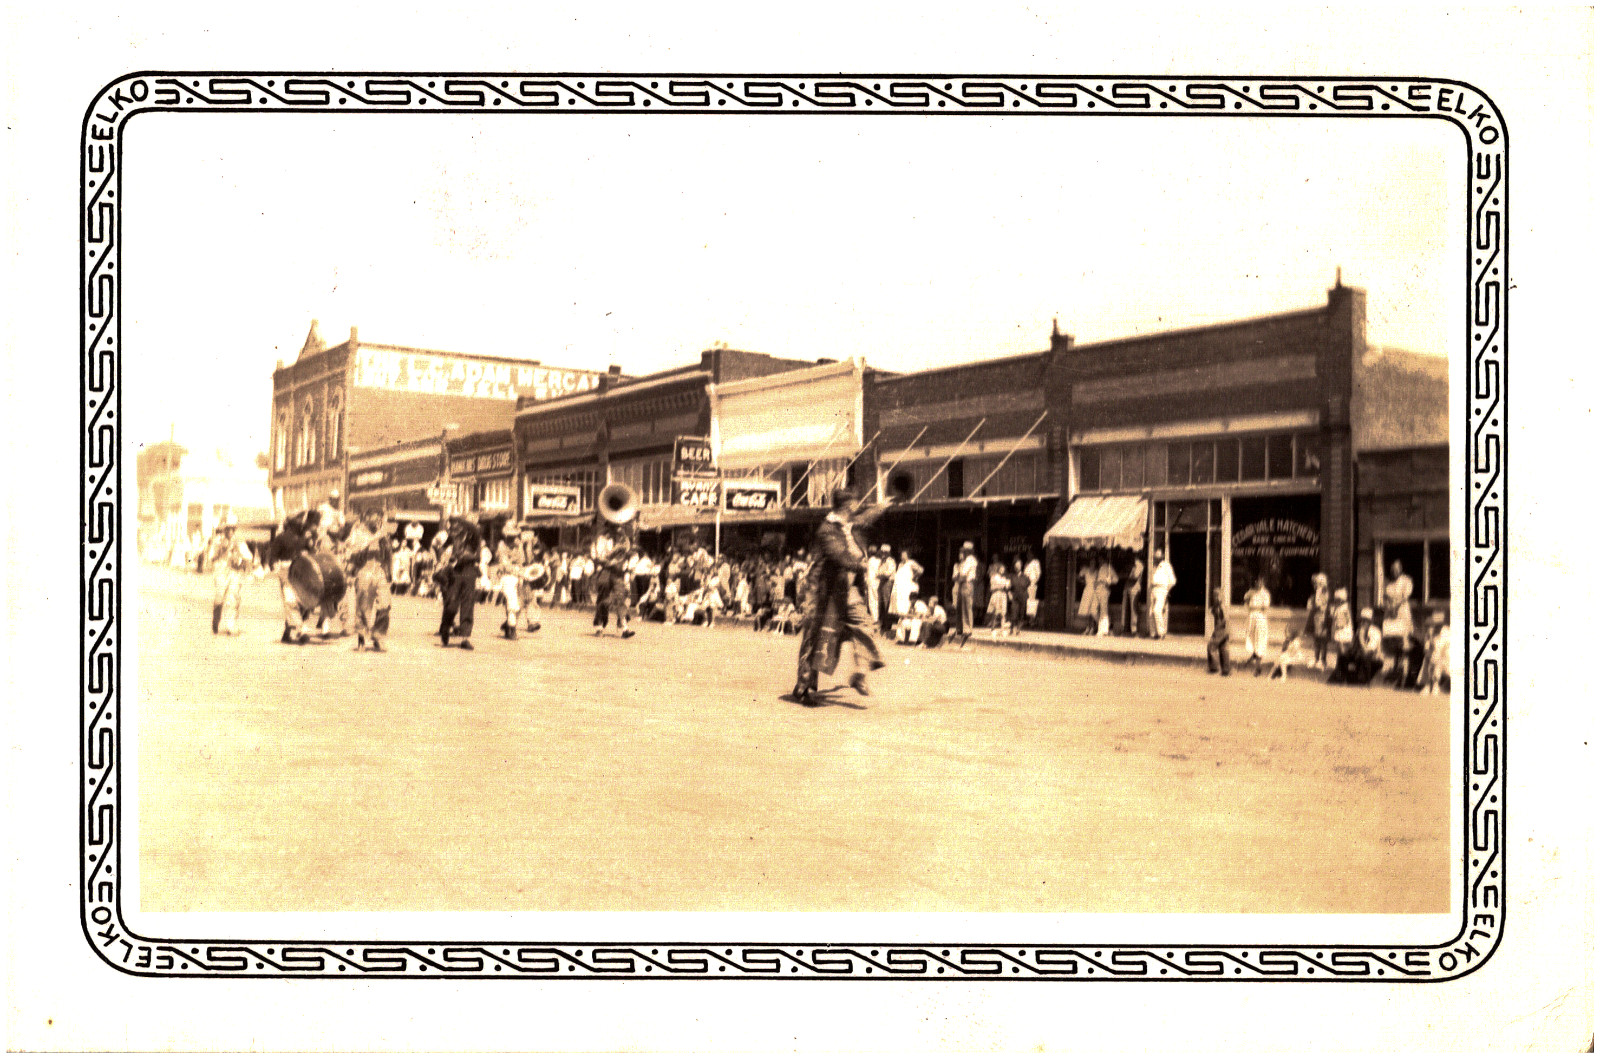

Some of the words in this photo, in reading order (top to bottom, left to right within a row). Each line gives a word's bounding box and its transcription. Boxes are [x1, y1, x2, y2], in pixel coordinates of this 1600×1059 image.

[91, 79, 149, 140] ELKO
[1437, 88, 1499, 145] ELKO
[681, 447, 711, 460] BEER
[681, 491, 718, 505] CAFE
[1276, 518, 1319, 546] HATCHERY
[91, 906, 152, 968] ELKO
[1438, 914, 1495, 972] ELKO
